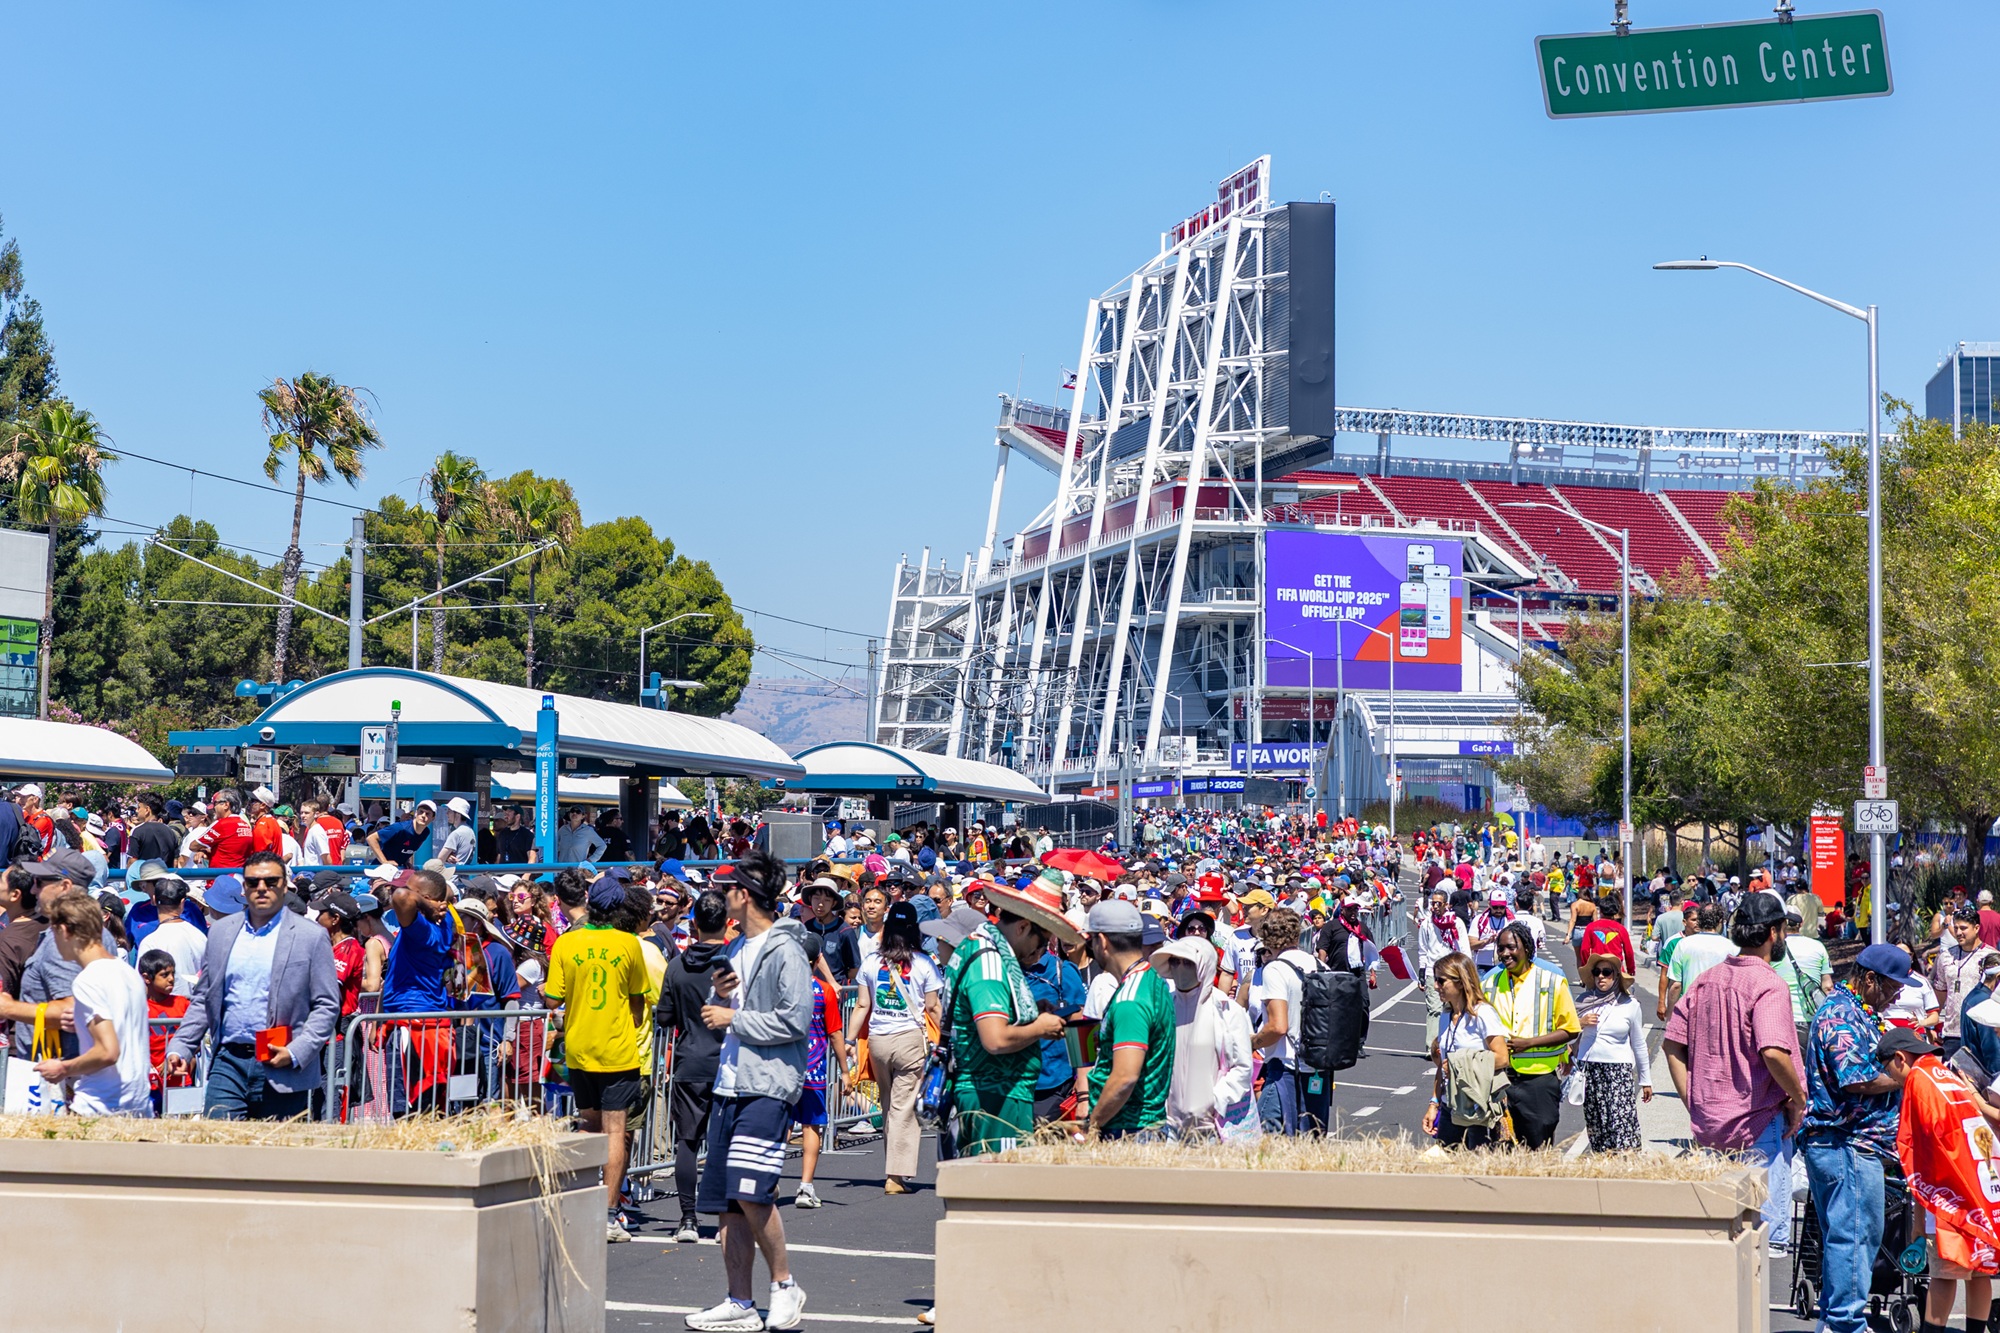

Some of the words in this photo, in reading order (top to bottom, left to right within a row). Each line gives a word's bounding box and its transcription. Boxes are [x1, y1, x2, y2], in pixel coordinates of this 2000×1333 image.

[1553, 48, 1739, 97] Convention
[1758, 38, 1872, 83] Center
[1314, 574, 1333, 588] GET
[1333, 575, 1351, 588] THE
[1277, 588, 1298, 601] FIFA
[1299, 589, 1335, 603] WORLD
[1335, 590, 1355, 604] CUP
[1302, 604, 1344, 619] OFFICIAL
[1346, 606, 1365, 619] APP
[364, 748, 375, 756] TAP
[374, 748, 386, 756] HER
[1471, 744, 1493, 753] Gate
[1494, 744, 1502, 753] A
[1214, 779, 1244, 790] 2026
[540, 761, 549, 837] EMERGENCY
[1877, 823, 1894, 831] LANE
[572, 947, 626, 968] KAKÁ
[585, 963, 608, 1011] 8
[884, 998, 901, 1007] FIFA
